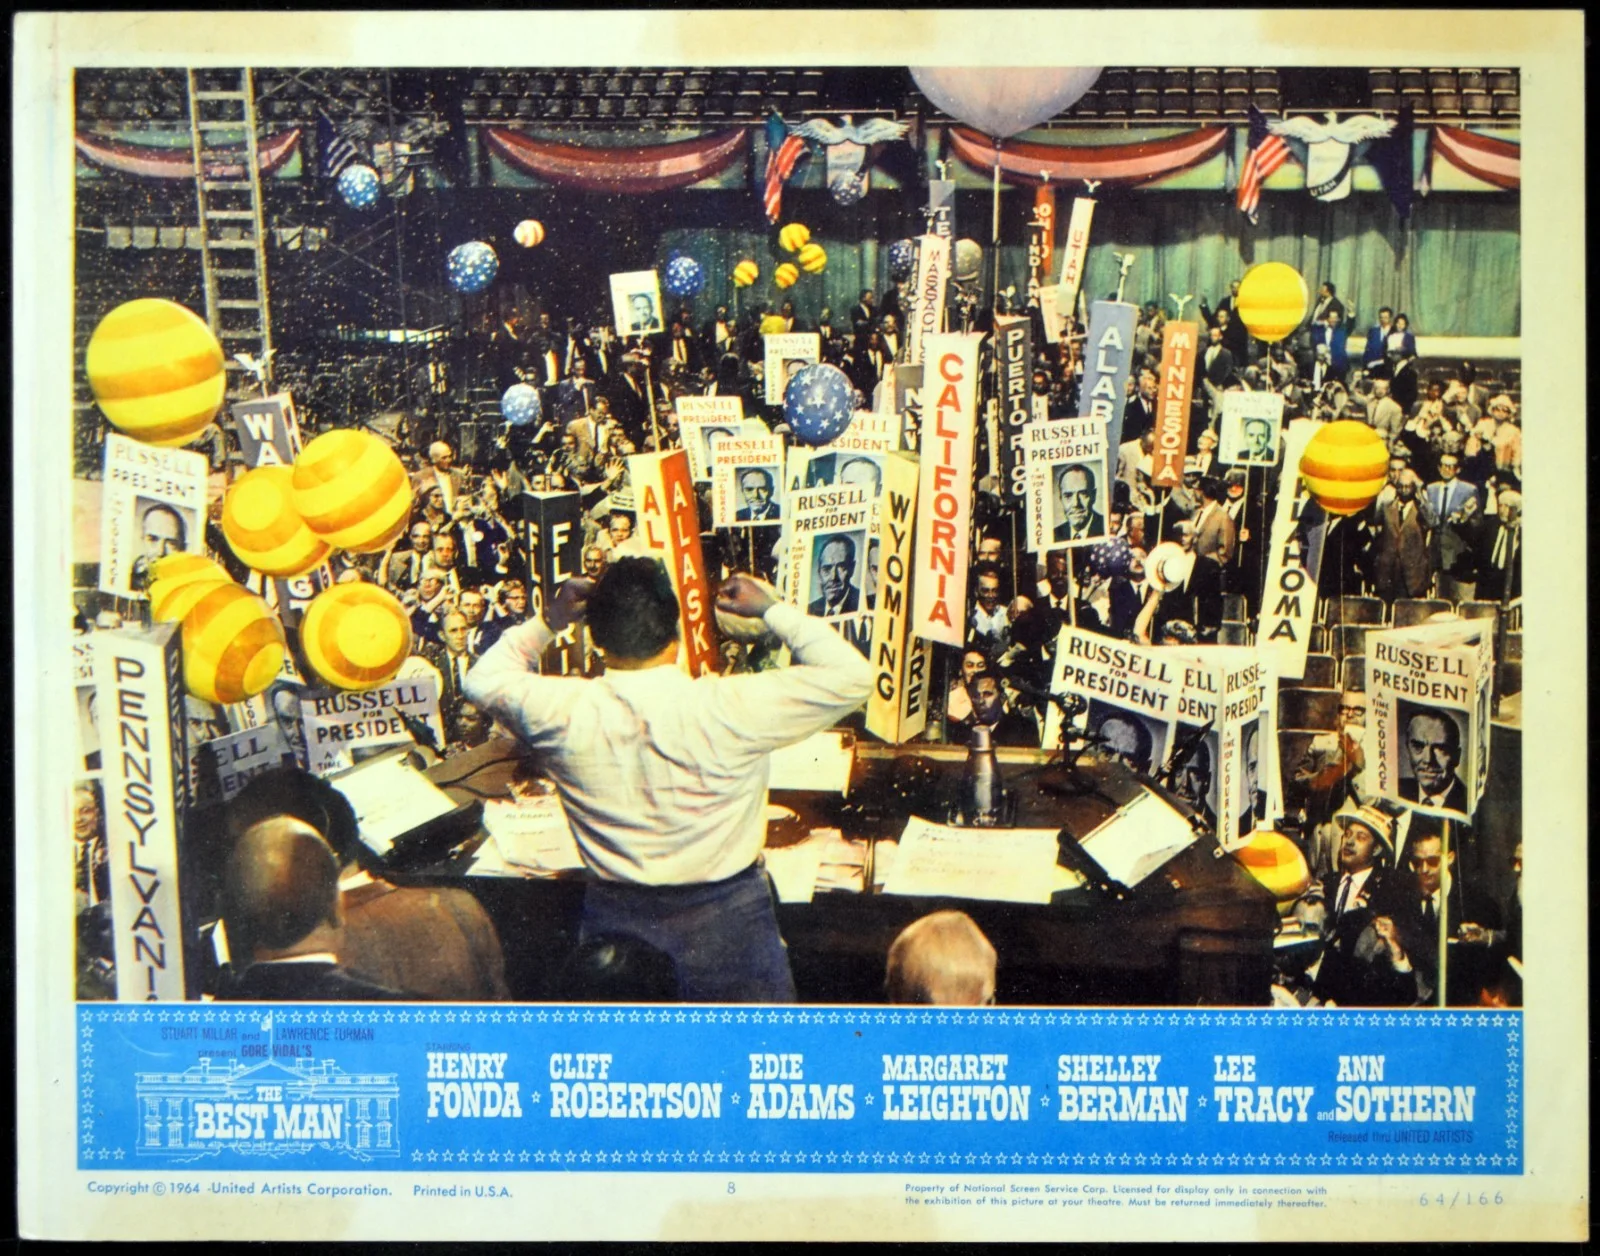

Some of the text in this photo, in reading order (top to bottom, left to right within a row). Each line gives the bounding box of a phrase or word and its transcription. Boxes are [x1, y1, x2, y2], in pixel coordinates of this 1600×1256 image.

[1027, 234, 1041, 308] INDIANA
[1065, 231, 1083, 284] UTAH
[1007, 329, 1028, 496] PUERTO RICO
[1156, 333, 1190, 480] MINNESOTA
[717, 440, 774, 452] RUSSELL
[829, 438, 891, 451] ESIDENT
[1031, 423, 1099, 442] RUSSELL
[717, 454, 778, 464] PRESIDENT
[1031, 443, 1100, 462] PRESIDENT
[797, 490, 867, 511] RUSSELL
[928, 353, 964, 628] CALIFORNIA
[795, 511, 867, 532] PRESIDENT
[1034, 489, 1044, 546] COURAGE
[877, 491, 910, 701] WYOMING
[1069, 636, 1173, 684] RUSSELL
[1109, 667, 1128, 679] FOR
[1375, 642, 1469, 679] RUSSELL
[1372, 668, 1468, 704] PRESIDENT
[1409, 669, 1426, 679] FOR
[315, 685, 427, 716] RUSSELL
[1062, 665, 1170, 712] PRESIDENT
[362, 710, 383, 719] FOR
[1372, 698, 1390, 710] TIME
[1374, 709, 1388, 719] FOR
[316, 713, 430, 743] PRESIDET
[1376, 719, 1388, 792] COURAGE
[114, 656, 165, 1000] PENNSYLVANI
[161, 1027, 375, 1041] STUART MILLAR and LAWRENCE TURMAN
[425, 1043, 471, 1051] STARRING
[198, 1045, 312, 1060] present GORE VIDAL'S
[427, 1053, 508, 1079] HENRY
[549, 1054, 613, 1080] CLIFF
[749, 1054, 804, 1080] EDIE
[882, 1054, 1008, 1081] MARGARET
[1058, 1055, 1162, 1082] SHELLEY
[1214, 1055, 1257, 1082] LEE
[1336, 1055, 1386, 1082] ANN
[256, 1086, 283, 1102] THE
[427, 1082, 522, 1118] FONDA
[550, 1083, 722, 1119] ROBERTSON
[747, 1084, 855, 1120] ADAMS
[882, 1085, 1031, 1121] LEIGHTON
[1058, 1086, 1189, 1122] BERMAN
[1214, 1086, 1314, 1122] TRACY
[1316, 1085, 1476, 1122] and SOTHERN
[194, 1103, 343, 1140] BEST MAN
[1328, 1130, 1474, 1144] Released thru UNITED ARTISTS
[87, 1181, 149, 1197] Copyright
[170, 1182, 201, 1194] 1964
[261, 1182, 302, 1195] Artists
[307, 1182, 393, 1198] Corporation.
[413, 1184, 514, 1198] Printed in U.S.A.
[727, 1181, 736, 1194] 8
[905, 1183, 1328, 1197] Property of National Screen Service Corp. Licensed for display only in connection with
[905, 1196, 1328, 1210] the exhibition of this picture at your theatre. Must be returned immediately thereafter.
